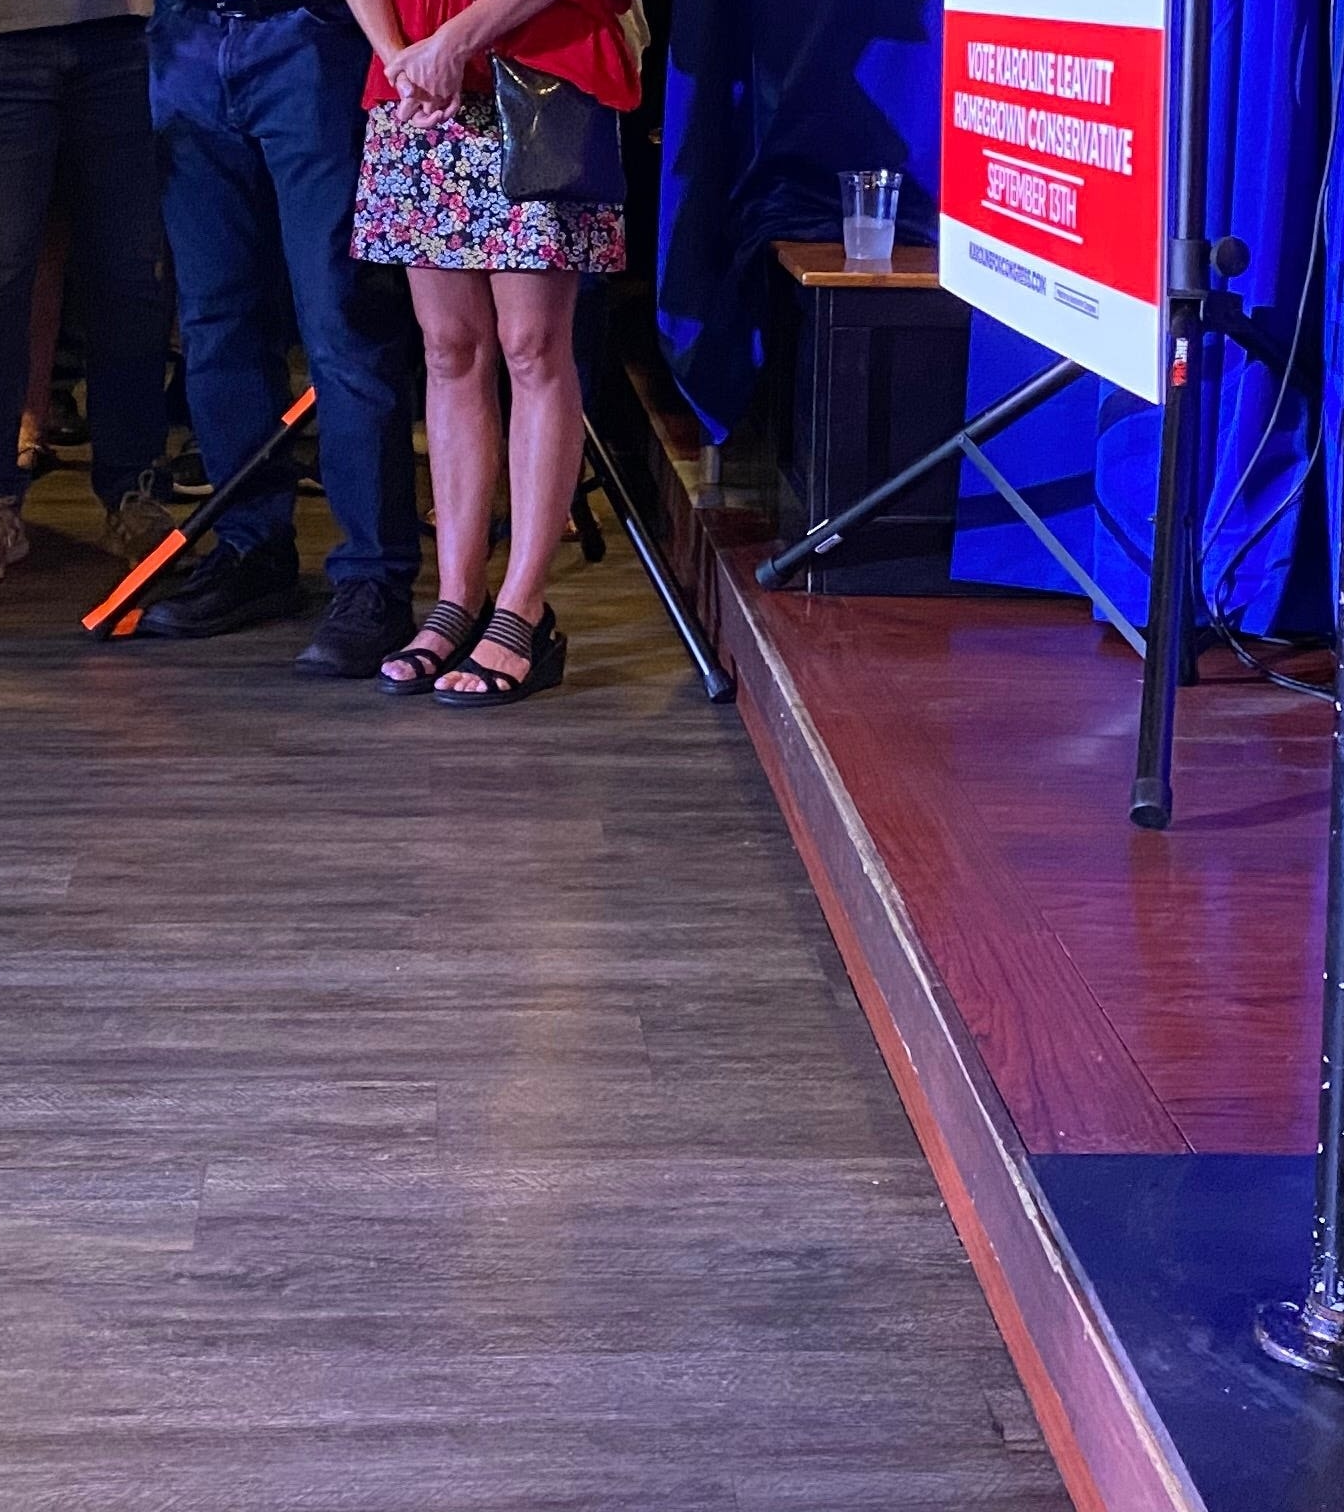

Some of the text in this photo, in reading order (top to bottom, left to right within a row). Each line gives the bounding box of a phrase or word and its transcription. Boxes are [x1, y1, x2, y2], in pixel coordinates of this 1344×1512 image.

[967, 41, 1115, 106] VOTE KAROLINE LEAVITT
[953, 91, 1134, 176] HOMEGROWN CONSERVATIVE
[987, 161, 1077, 230] SEPTEMBER 13TH
